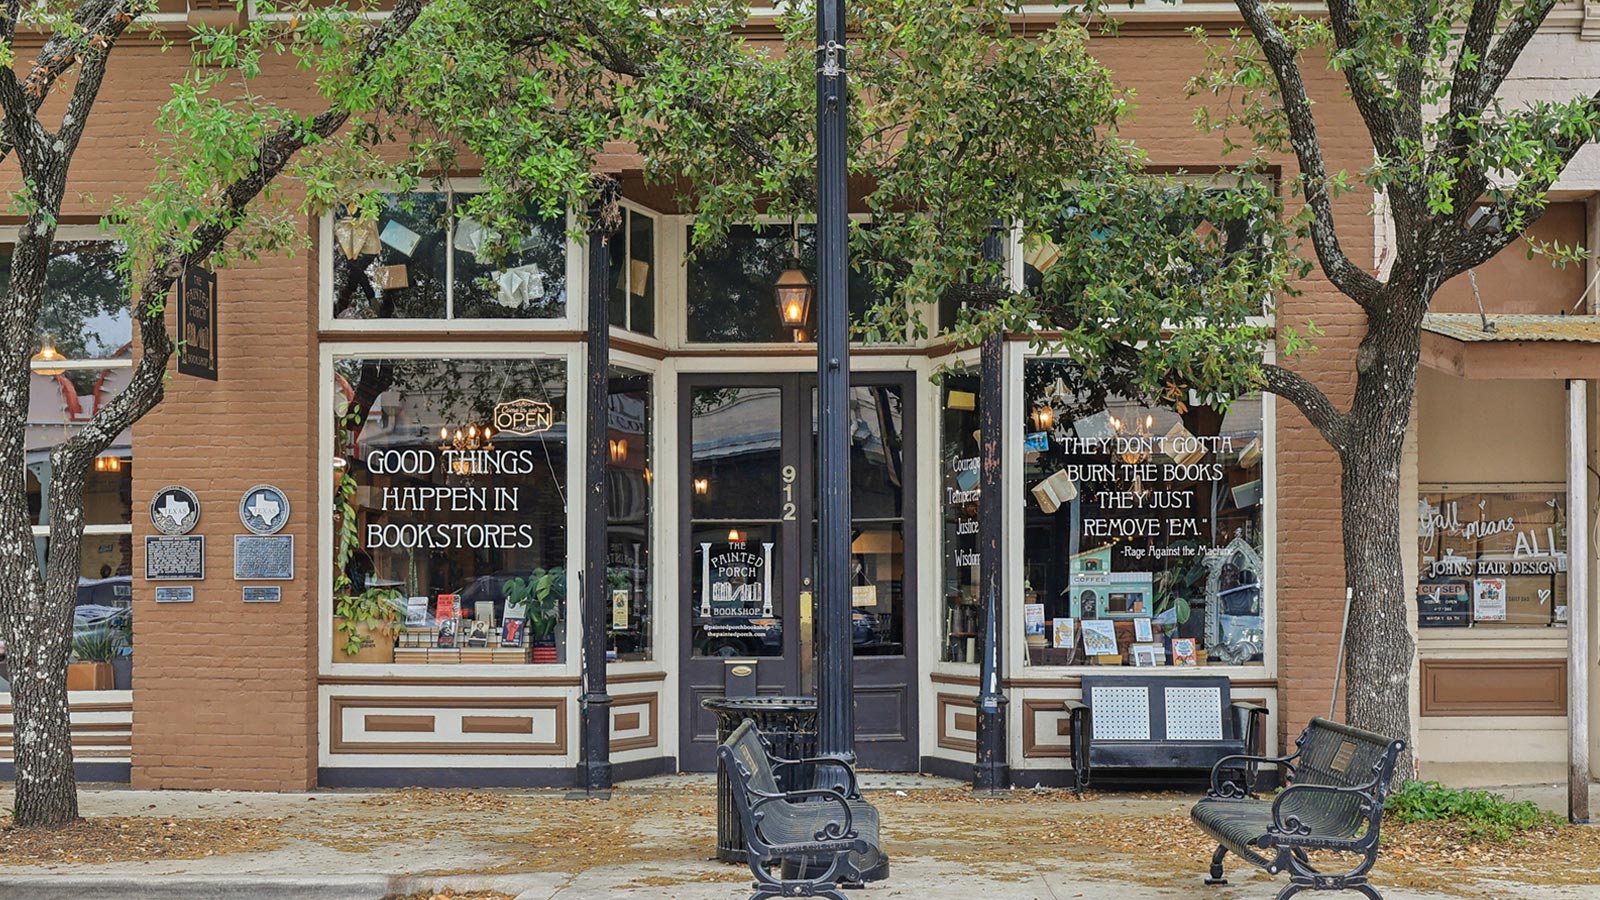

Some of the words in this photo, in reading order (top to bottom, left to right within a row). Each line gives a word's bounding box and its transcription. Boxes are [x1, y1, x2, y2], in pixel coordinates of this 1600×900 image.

[498, 412, 550, 428] OPEN
[1056, 436, 1111, 455] "THEY
[1116, 436, 1169, 455] DON'T
[1173, 436, 1234, 454] GOTTA
[367, 450, 435, 474] GOOD
[442, 450, 534, 475] THINGS
[1067, 464, 1116, 482] BURN
[1121, 464, 1158, 482] THE
[1163, 463, 1224, 481] BOOKS
[381, 487, 487, 511] HAPPEN
[494, 487, 519, 511] IN
[782, 464, 796, 521] 912
[1097, 491, 1148, 509] THEY
[1150, 491, 1194, 509] JUST
[164, 506, 187, 514] TEXAS
[253, 506, 278, 514] TEXAS
[956, 517, 979, 535] Justice
[1084, 518, 1161, 537] REMOVE
[1166, 518, 1208, 537] 'EM."
[367, 524, 534, 549] BOOKSTORES
[1462, 515, 1516, 540] means
[1513, 527, 1567, 558] ALL
[729, 542, 746, 550] THE
[1120, 545, 1146, 559] -Rage
[1148, 545, 1180, 559] Against
[1183, 545, 1196, 557] the
[1198, 545, 1234, 557] Machine
[711, 552, 764, 568] PAINTED
[1428, 561, 1473, 578] JOHN'S
[1478, 561, 1508, 575] HAIR
[1512, 560, 1557, 575] DESIGN
[718, 567, 757, 577] PORCH
[1421, 585, 1463, 594] CLOSED
[713, 607, 761, 616] BOOKSHOP
